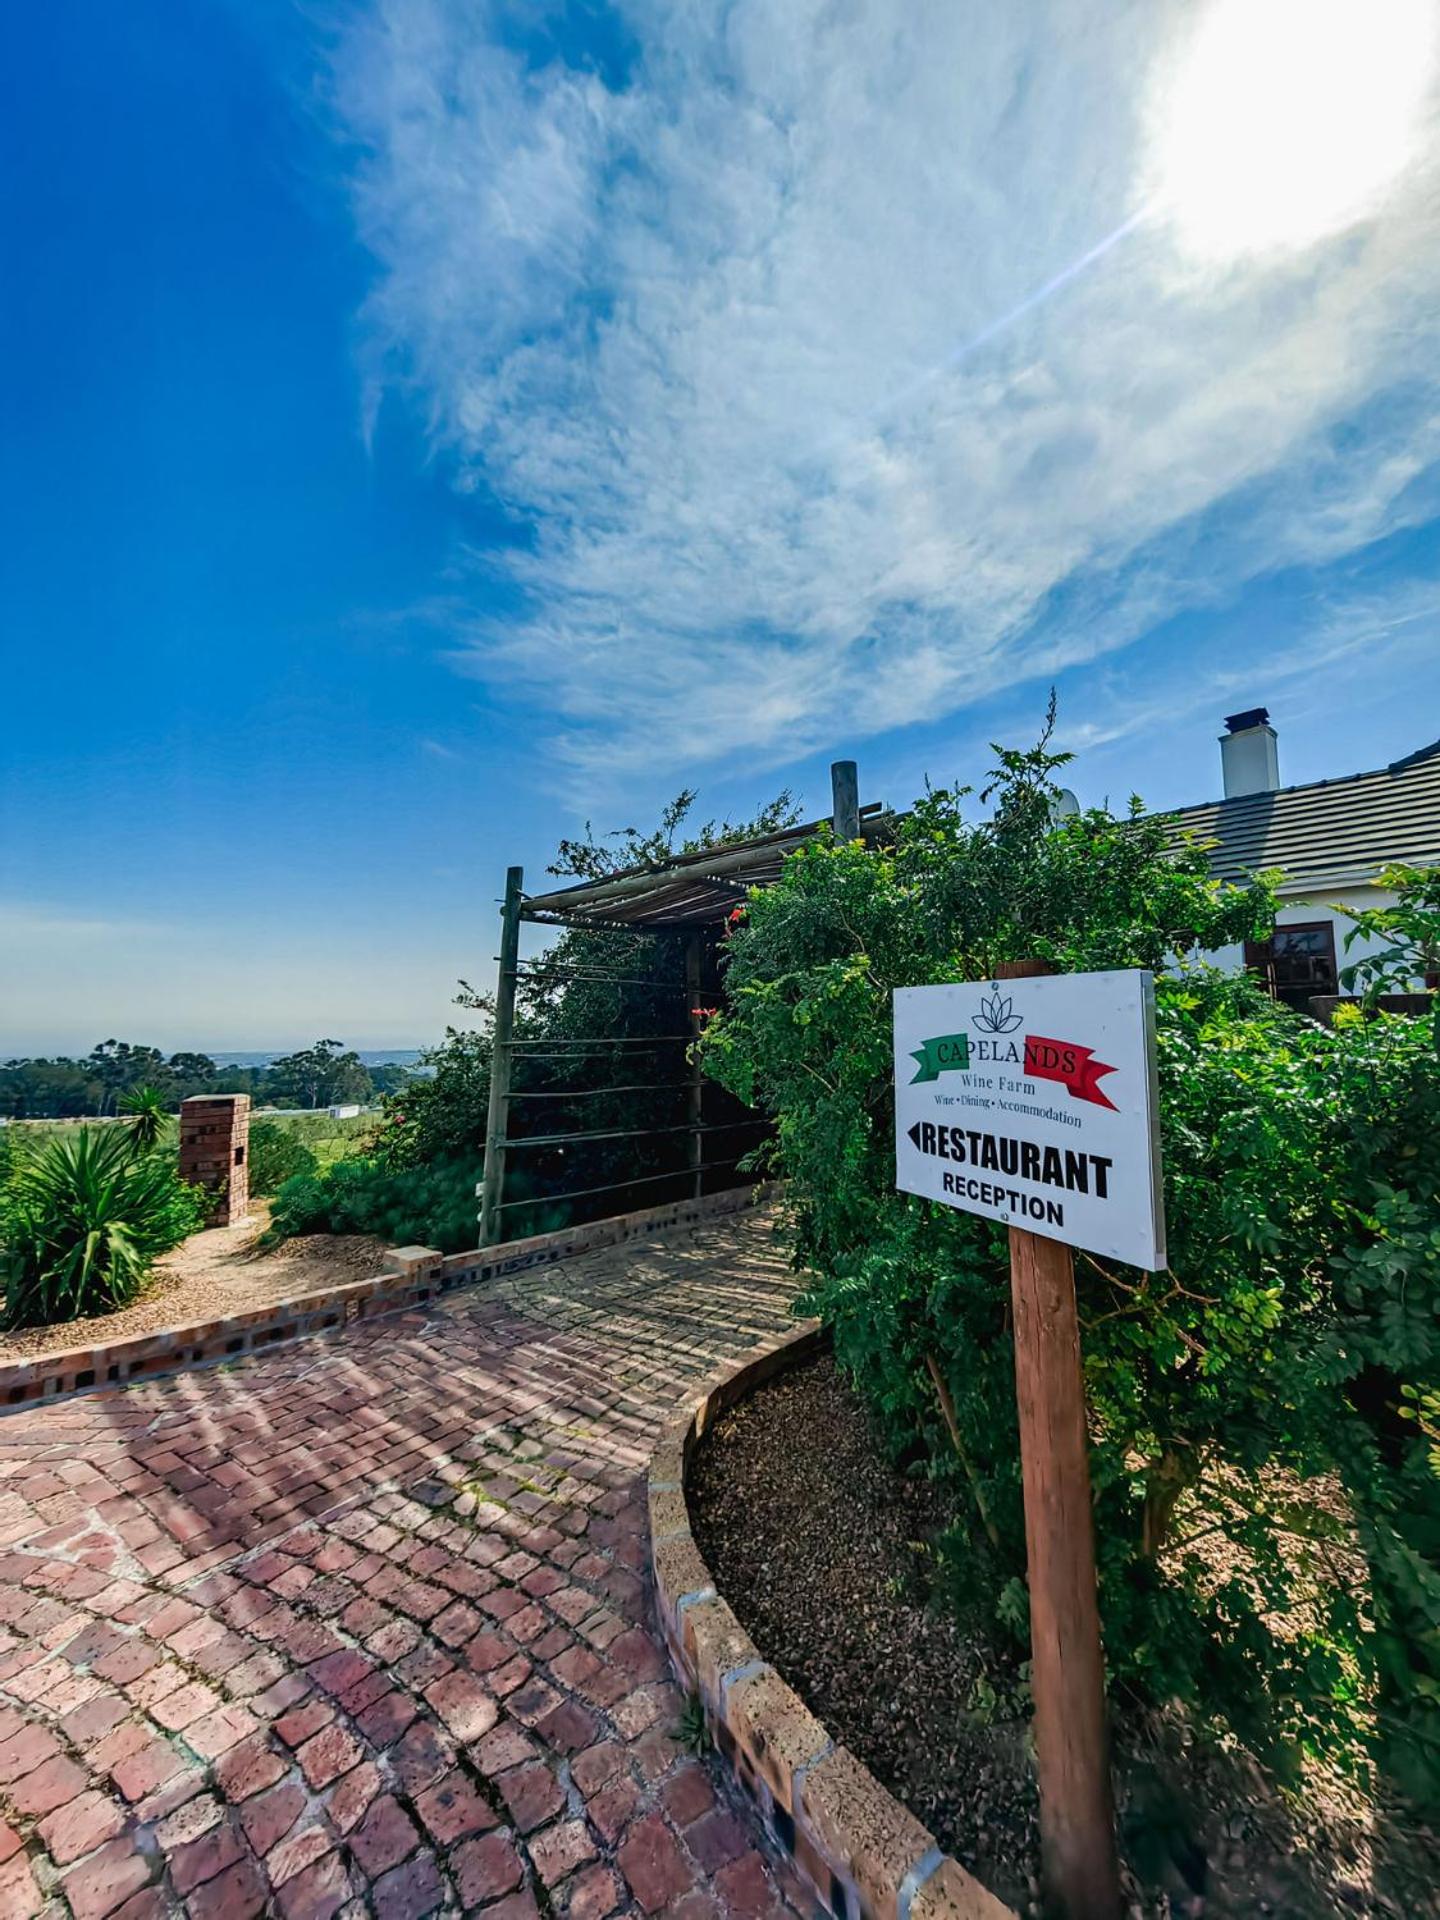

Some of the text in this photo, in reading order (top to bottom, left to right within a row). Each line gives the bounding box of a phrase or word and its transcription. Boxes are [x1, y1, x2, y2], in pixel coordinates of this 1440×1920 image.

[937, 1041, 1076, 1074] CAPELANDS
[961, 1074, 1036, 1095] Wine Farm
[997, 1099, 1082, 1128] Accommodation
[920, 1122, 1112, 1199] RESTAURANT
[943, 1172, 1064, 1227] RECEPTION
